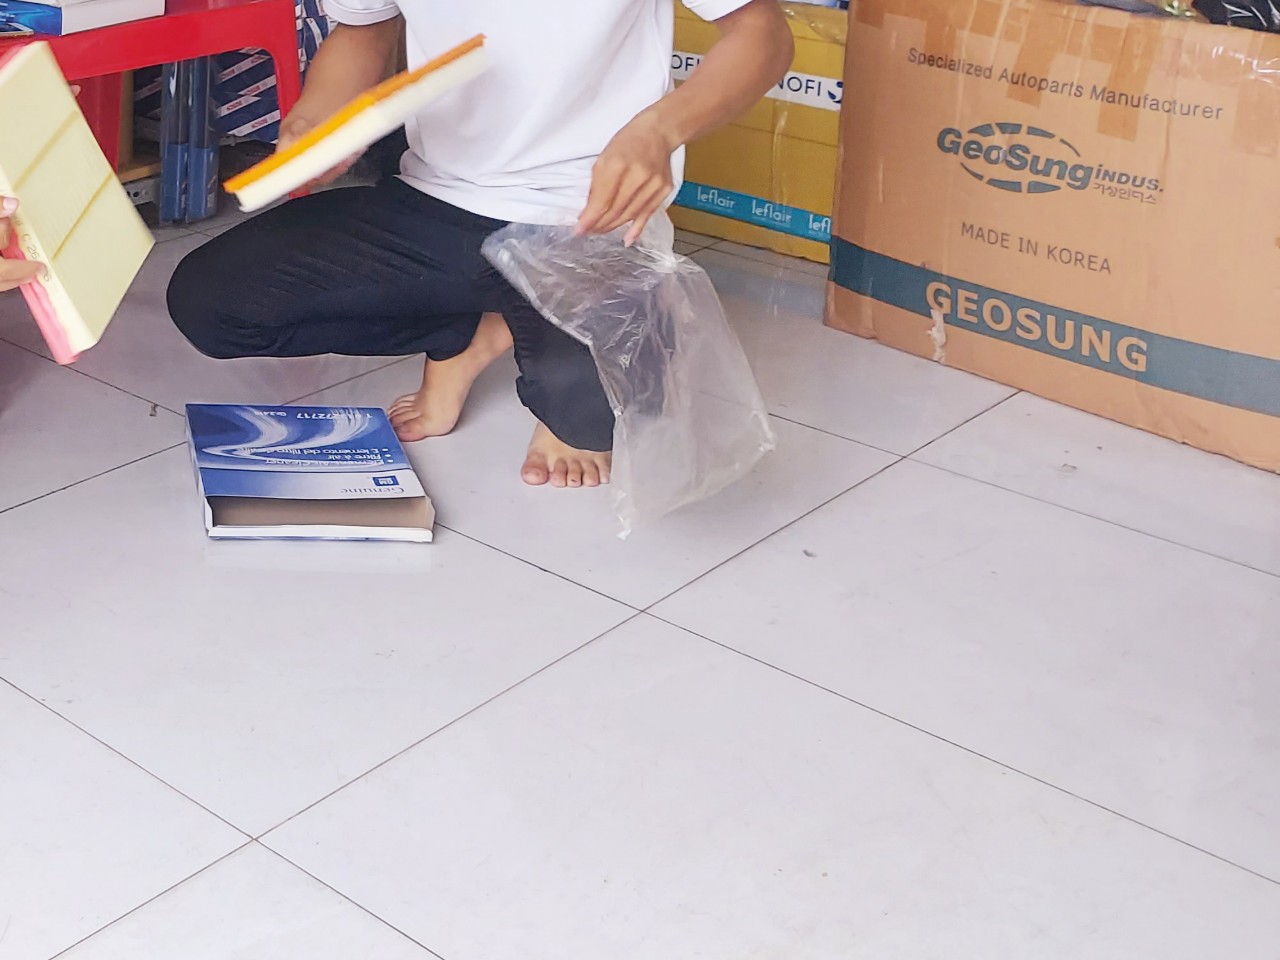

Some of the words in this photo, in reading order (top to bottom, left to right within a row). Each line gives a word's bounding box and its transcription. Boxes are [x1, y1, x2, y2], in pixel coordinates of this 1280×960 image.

[907, 47, 993, 80] Specialized
[998, 67, 1084, 98] Autoparts
[1089, 84, 1224, 121] Manufacturer
[937, 127, 1094, 190] GeoSung
[697, 186, 737, 209] leflair
[752, 199, 792, 222] leflair
[960, 221, 1012, 250] MADE
[1017, 236, 1039, 256] IN
[1046, 244, 1113, 275] KOREA
[925, 281, 1149, 373] GEOSUNG
[340, 486, 405, 494] Genuine
